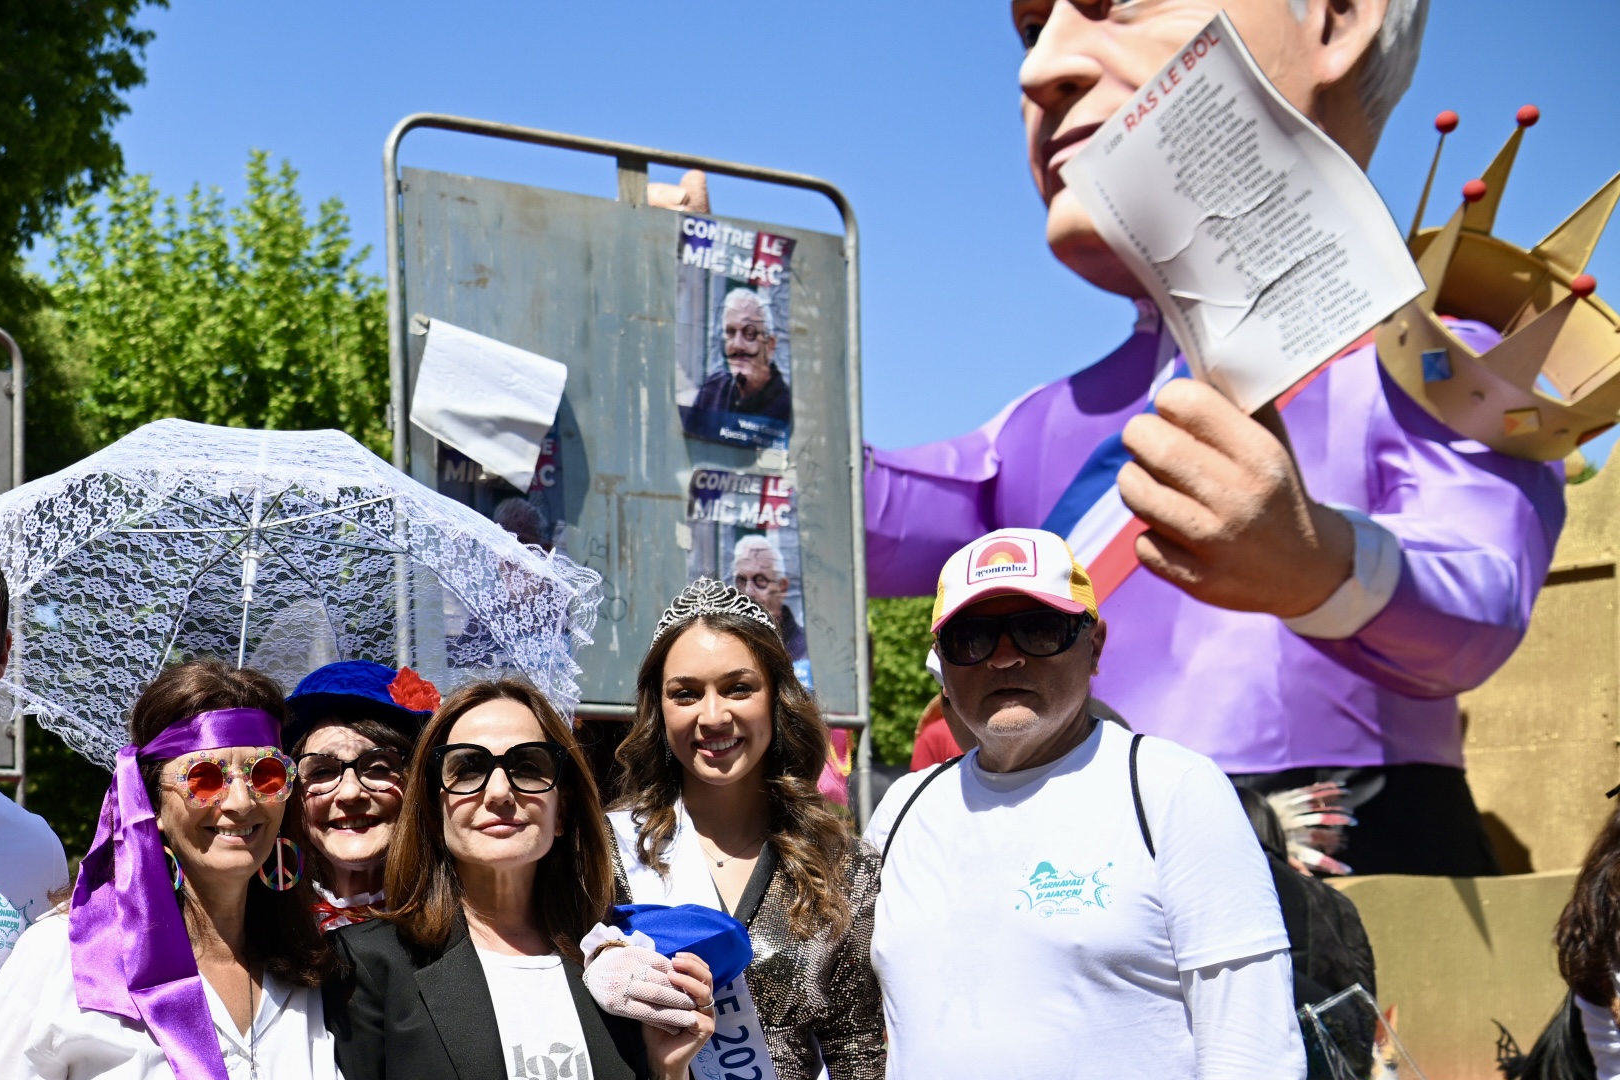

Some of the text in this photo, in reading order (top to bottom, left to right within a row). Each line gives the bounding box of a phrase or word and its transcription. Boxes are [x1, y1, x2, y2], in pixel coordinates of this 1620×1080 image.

[1124, 91, 1158, 132] RAS
[1160, 65, 1181, 95] LE
[1182, 31, 1220, 71] BOL
[683, 218, 787, 256] CONTRE LE
[682, 243, 783, 285] MIC MAC
[695, 472, 790, 497] CONTRE LE
[692, 497, 791, 526] MIC MAC
[1036, 878, 1086, 891] CARNAVALI
